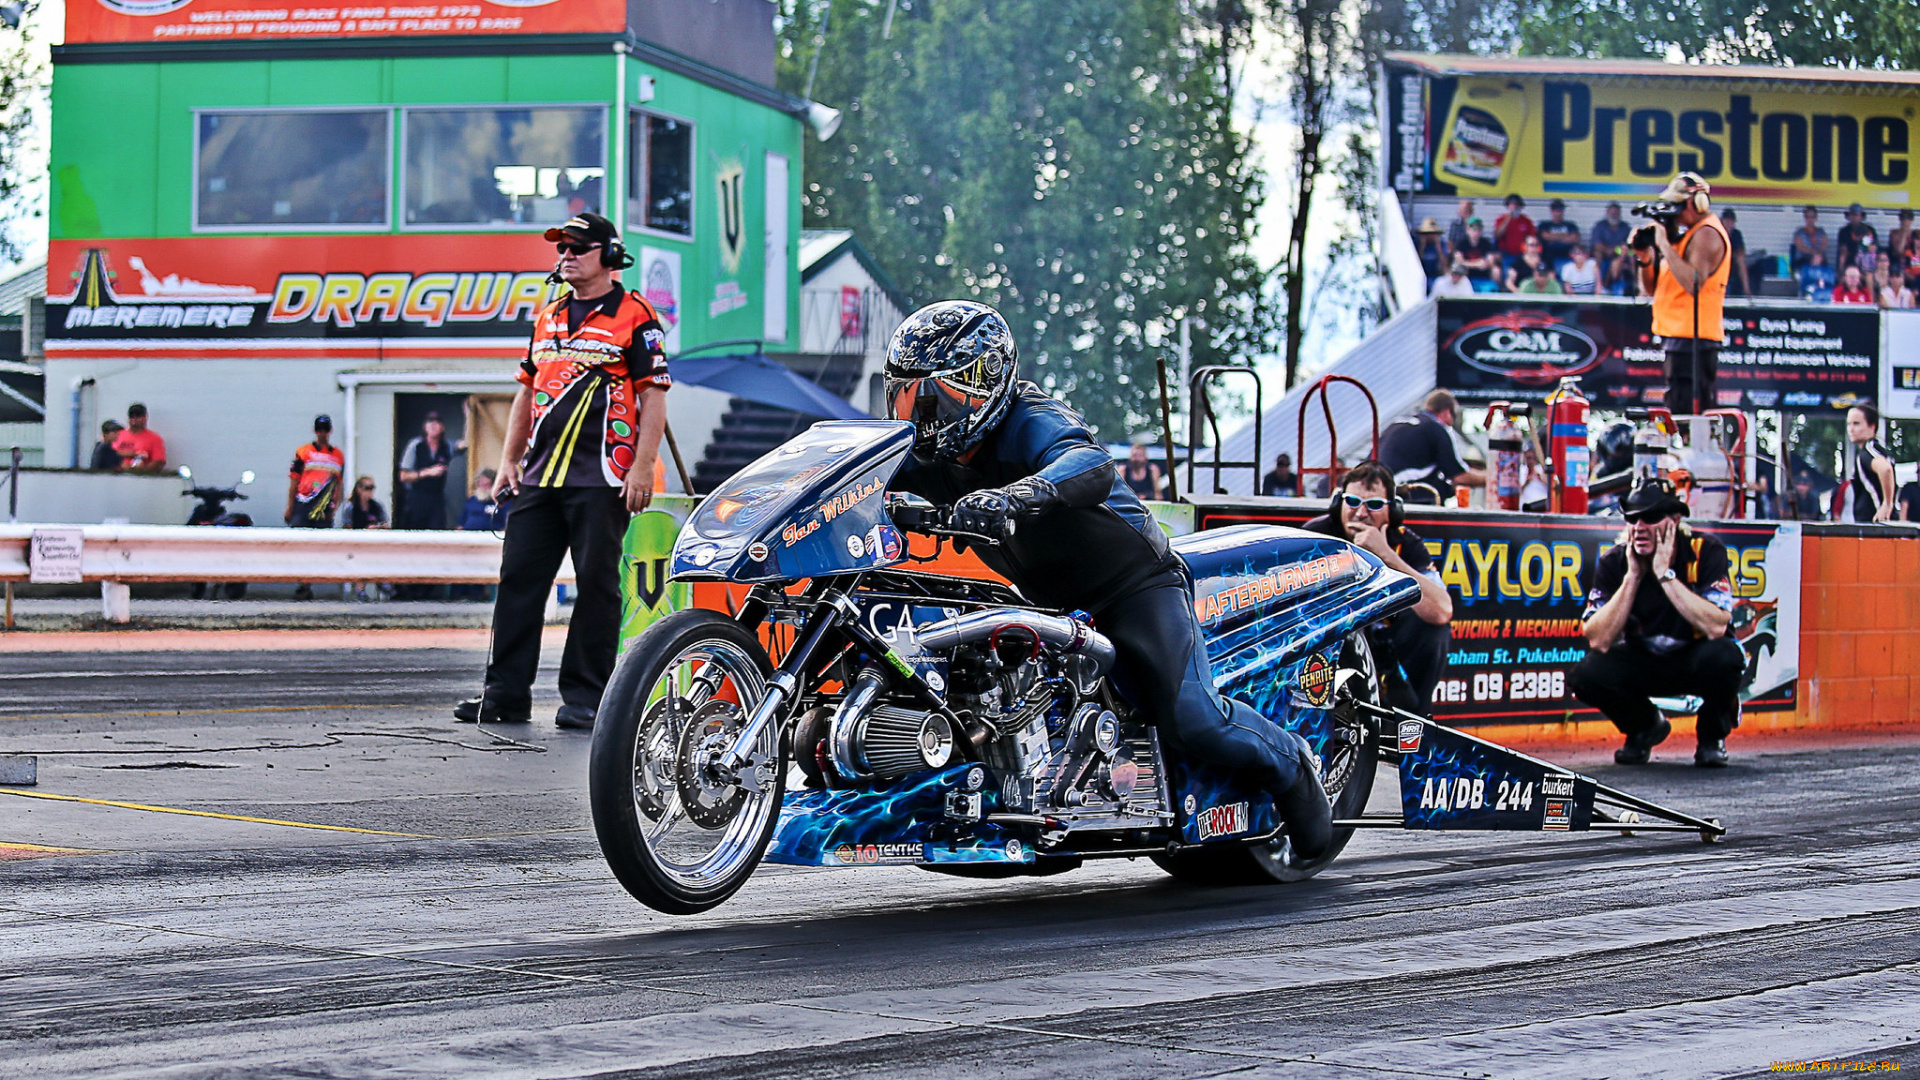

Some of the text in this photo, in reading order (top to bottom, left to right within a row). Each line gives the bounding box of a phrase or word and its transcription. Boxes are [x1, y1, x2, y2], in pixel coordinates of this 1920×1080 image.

[190, 9, 289, 22] WELCOMING
[292, 8, 338, 20] RACE
[340, 7, 385, 19] FANS
[389, 6, 439, 18] SINCE
[153, 17, 523, 37] PARTNERS IN PROVIDING A SAFE PLACE TO RACE
[1543, 80, 1909, 185] Prestone
[267, 272, 568, 328] DRAGWA
[64, 305, 255, 330] MEREMERE
[1759, 317, 1789, 333] Dyno
[1790, 318, 1826, 336] Tuning
[1747, 333, 1783, 350] Speed
[1784, 335, 1843, 351] Equipment
[1744, 351, 1756, 365] of
[1773, 352, 1826, 366] American
[1826, 353, 1871, 368] Vehicles
[819, 476, 884, 523] Wilkins
[1205, 557, 1330, 620] AFTERBURNER
[1450, 618, 1586, 639] RVICING & MECHANICA
[1447, 647, 1586, 665] aham St. Pukekohe
[1299, 667, 1334, 690] PENRITE
[1473, 672, 1504, 701] 09
[1400, 724, 1421, 733] IHRA
[1420, 777, 1533, 812] AA/DB 244
[856, 843, 923, 863] 10 TENTHS
